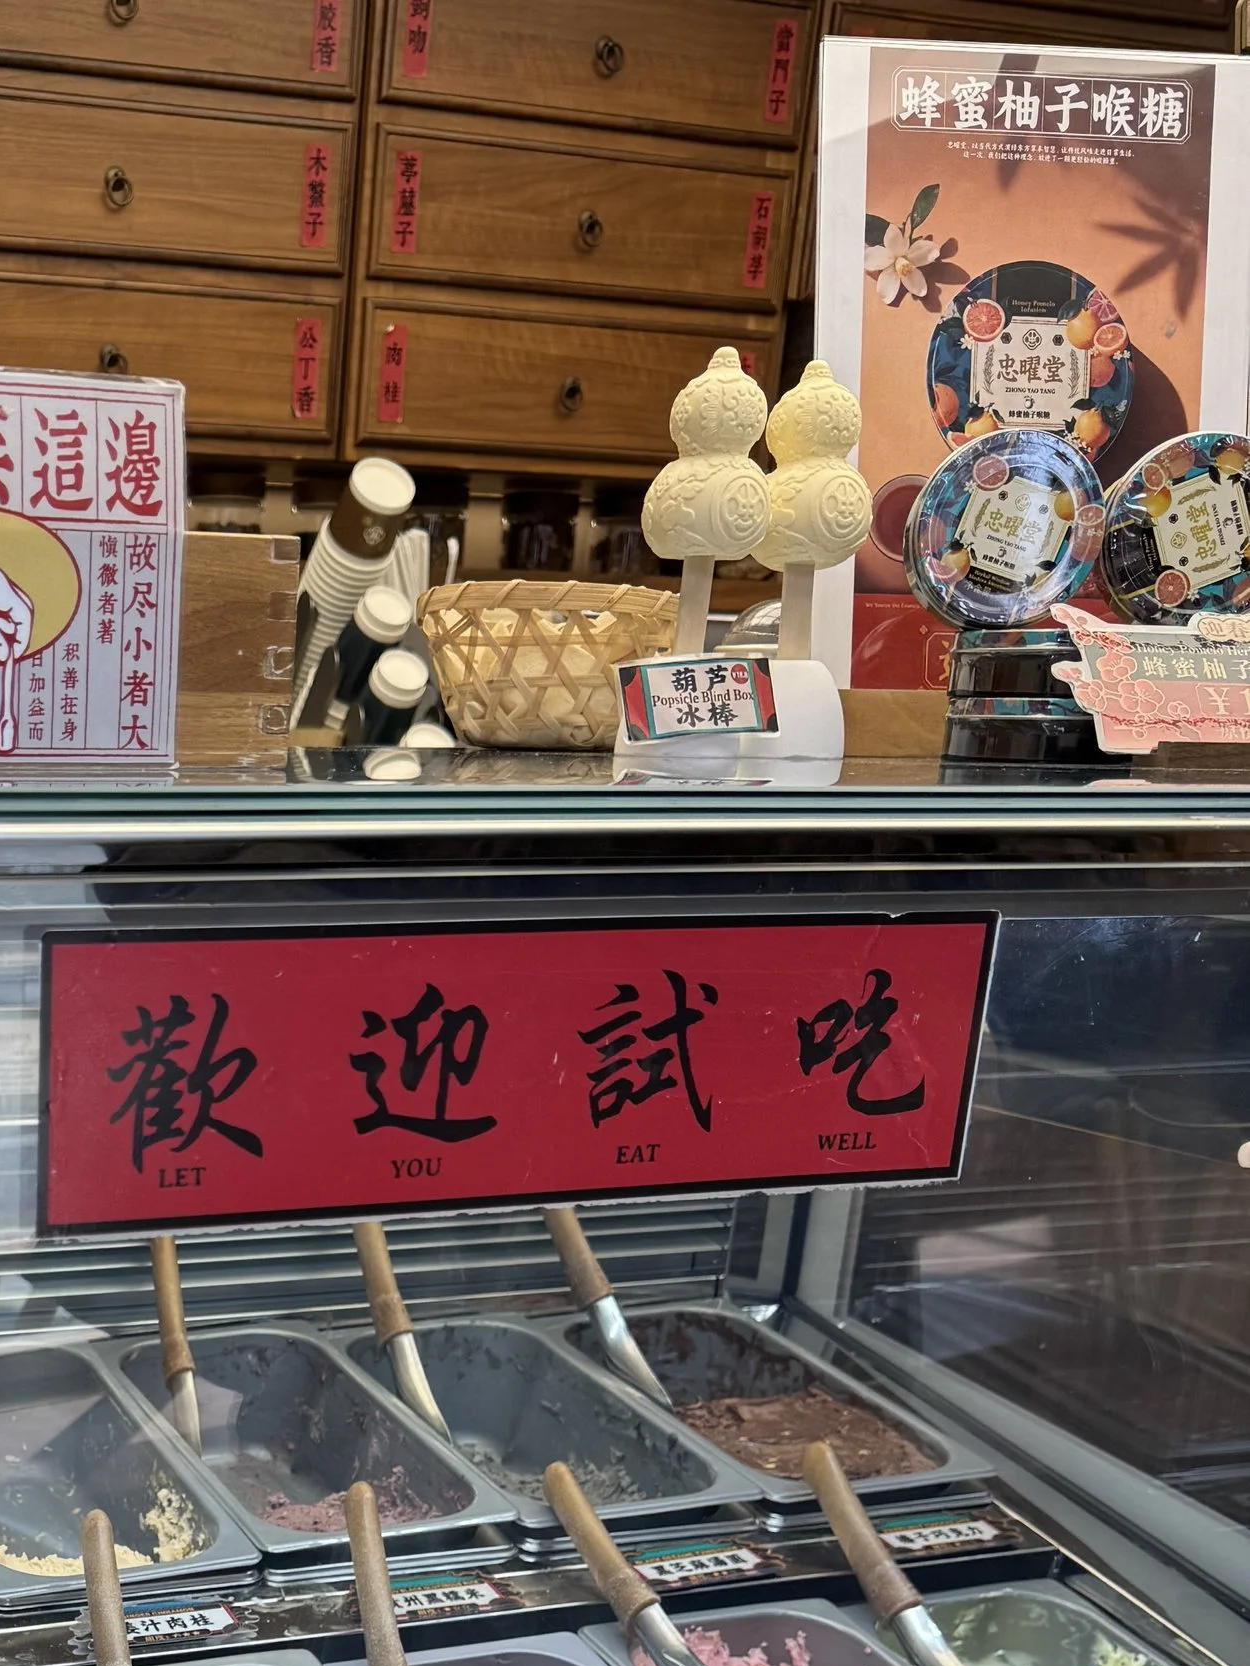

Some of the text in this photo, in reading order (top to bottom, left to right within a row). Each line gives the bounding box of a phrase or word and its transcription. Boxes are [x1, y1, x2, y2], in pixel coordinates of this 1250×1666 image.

[899, 74, 1185, 138] 蜂蜜柚子喉糖
[305, 148, 328, 237] 木鱉子
[296, 326, 319, 414] 公丁香
[996, 353, 1066, 384] 忠曜堂
[983, 507, 1043, 545] 忠曜堂
[1186, 501, 1218, 561] 忠曜堂
[120, 534, 157, 751] 故尽小者大
[60, 643, 80, 743] 积善在身
[652, 689, 755, 708] Popsicle Blind Box
[671, 664, 729, 693] 葫芦
[676, 702, 739, 728] 冰棒
[105, 967, 927, 1176] 歡迎試吃
[158, 1132, 877, 1190] LET YOU EAT WELL
